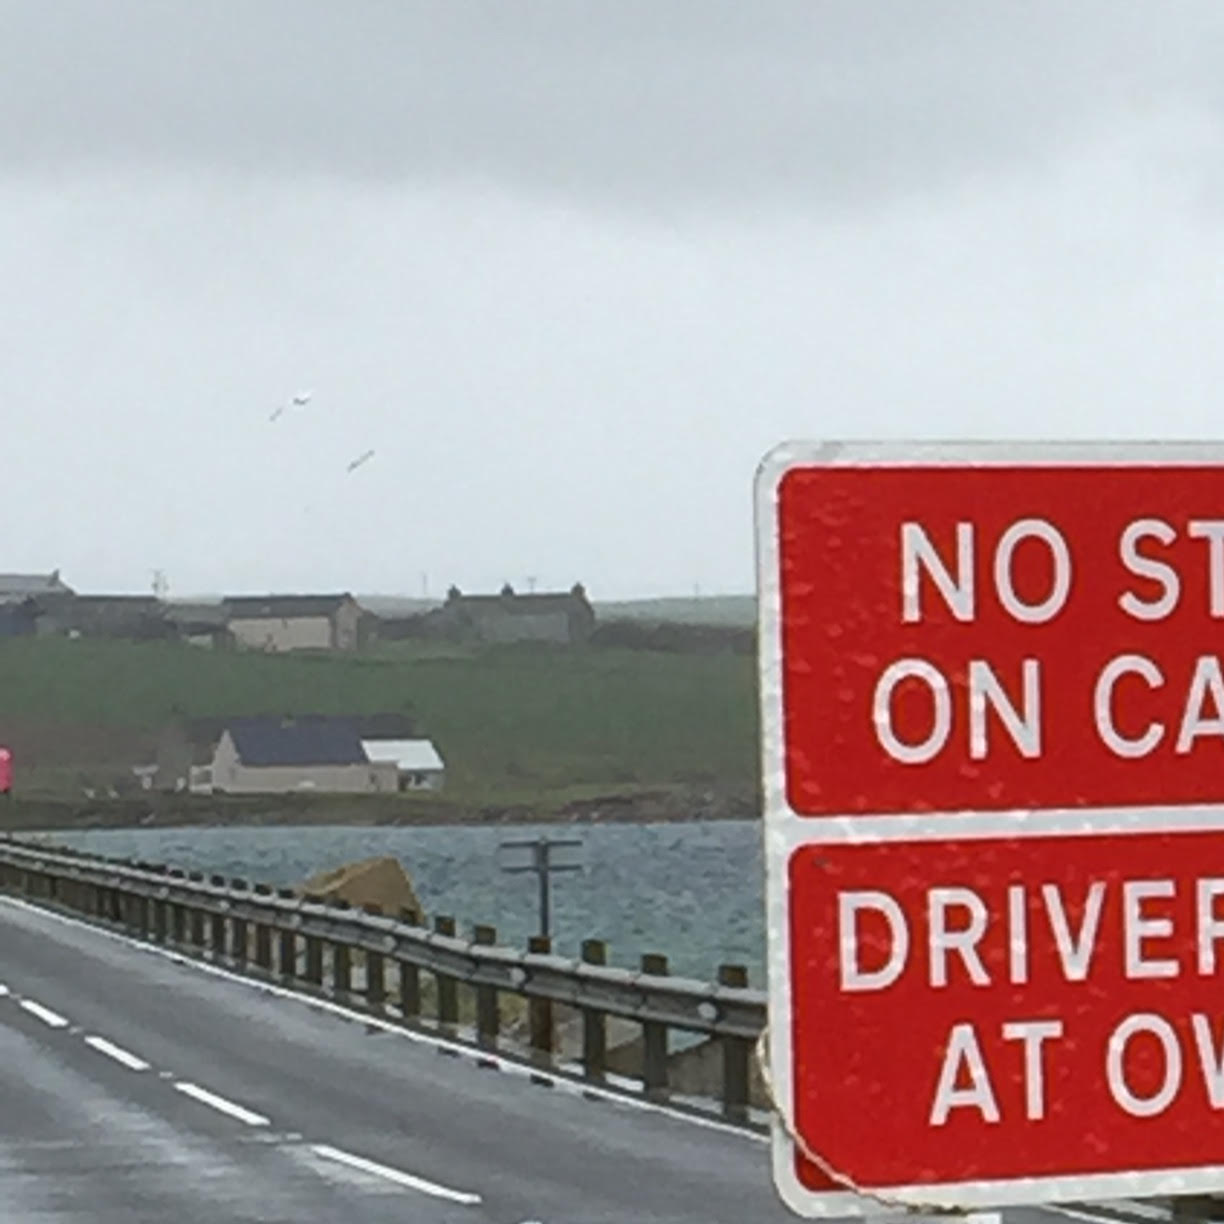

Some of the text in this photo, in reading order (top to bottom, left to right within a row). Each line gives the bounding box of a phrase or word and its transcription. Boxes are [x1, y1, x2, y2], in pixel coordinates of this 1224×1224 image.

[901, 519, 1072, 623] NO
[872, 657, 1042, 764] ON
[929, 1020, 1063, 1126] AT
